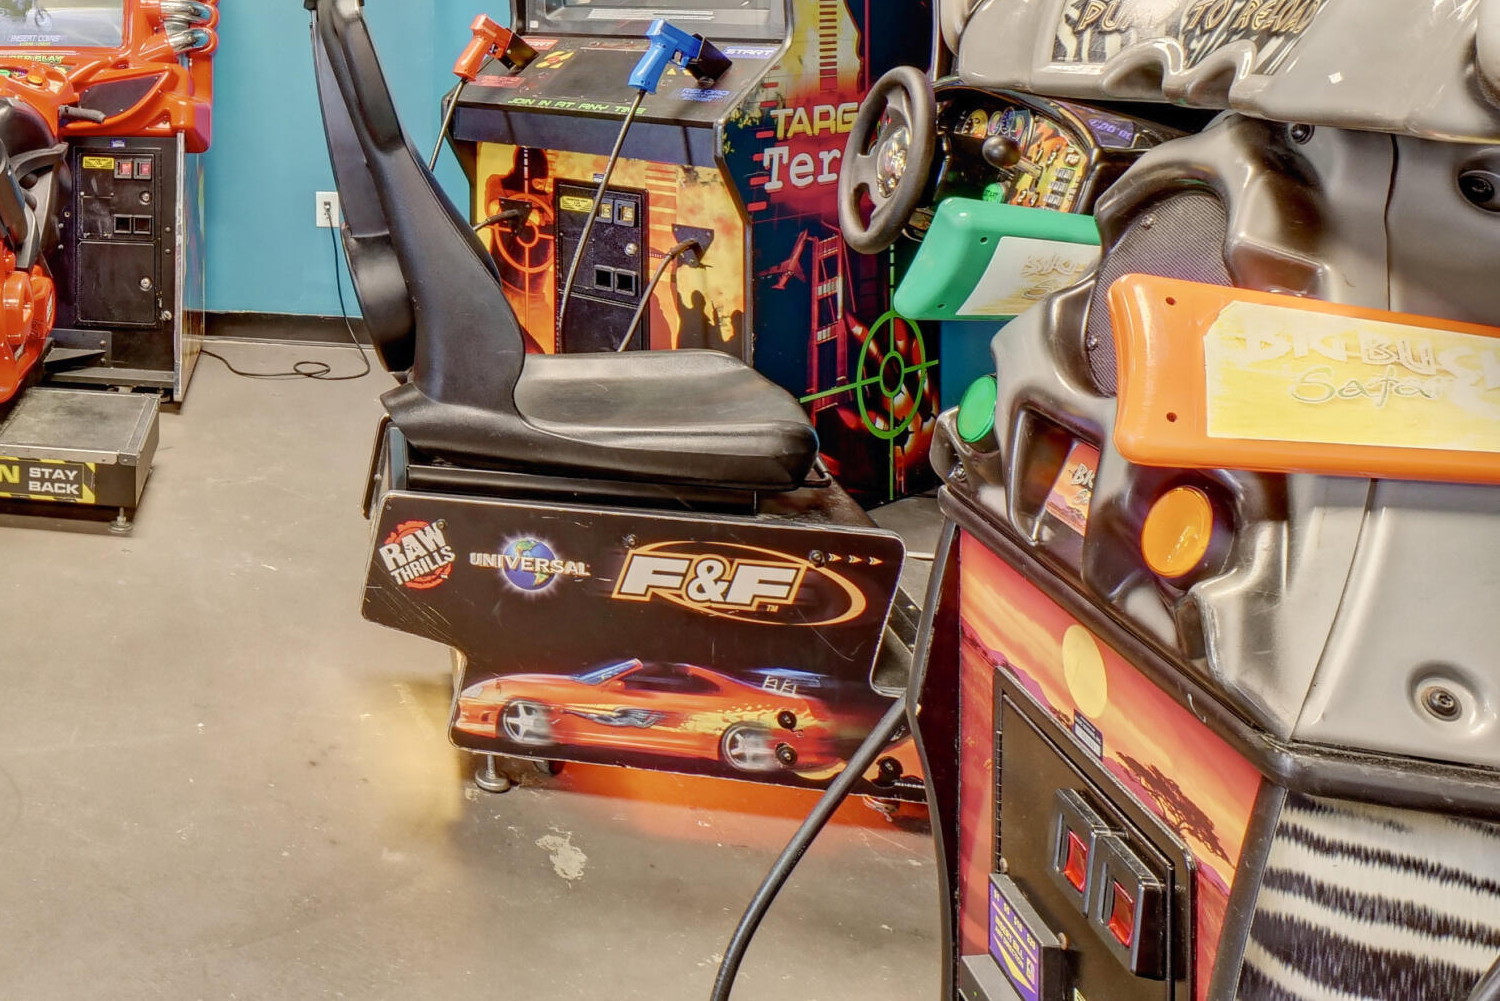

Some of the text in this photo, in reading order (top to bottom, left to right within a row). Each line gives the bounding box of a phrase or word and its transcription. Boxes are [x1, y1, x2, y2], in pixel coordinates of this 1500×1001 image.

[28, 466, 78, 480] STAY
[28, 480, 80, 496] BACK
[378, 522, 447, 571] RAW
[389, 545, 457, 586] THRILLS
[469, 551, 591, 577] UNIVERSAL
[613, 550, 806, 610] F&F
